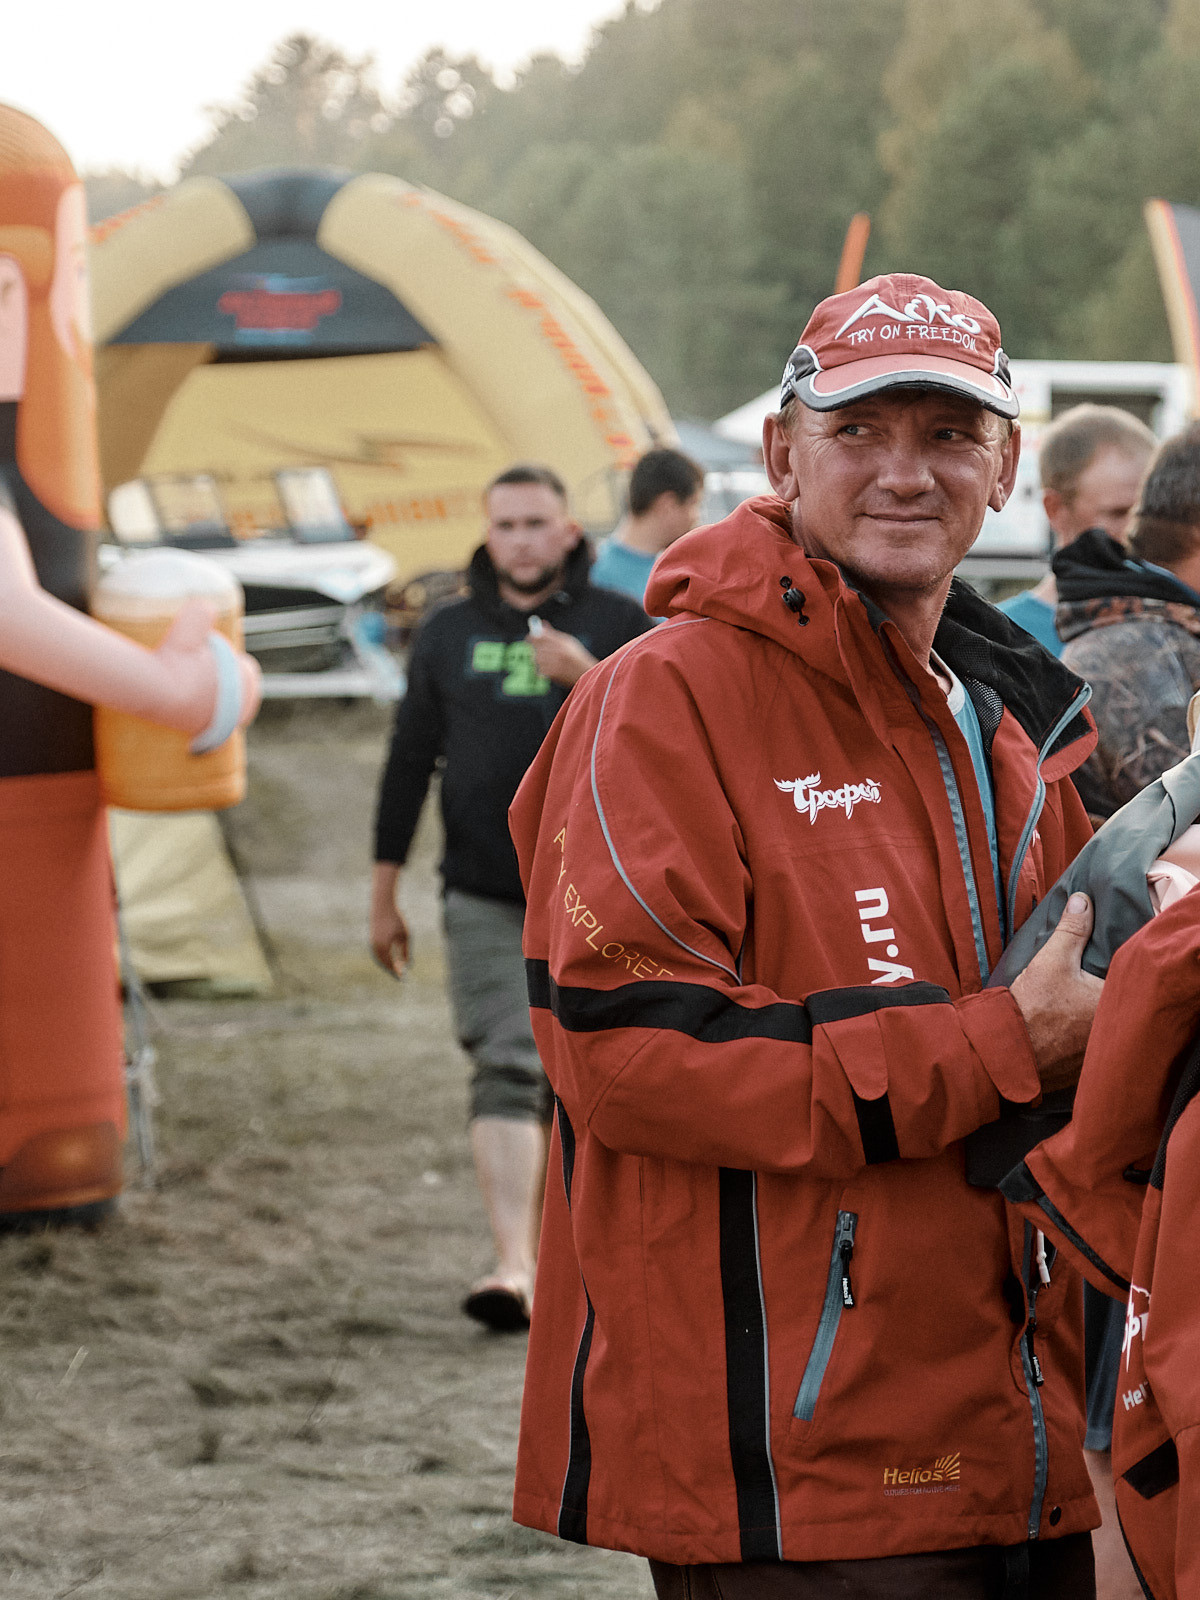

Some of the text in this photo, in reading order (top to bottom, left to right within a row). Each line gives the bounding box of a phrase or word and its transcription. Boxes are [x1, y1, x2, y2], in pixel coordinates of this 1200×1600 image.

[847, 324, 977, 352] TRY ON FREEDOM
[884, 1467, 943, 1485] Helios
